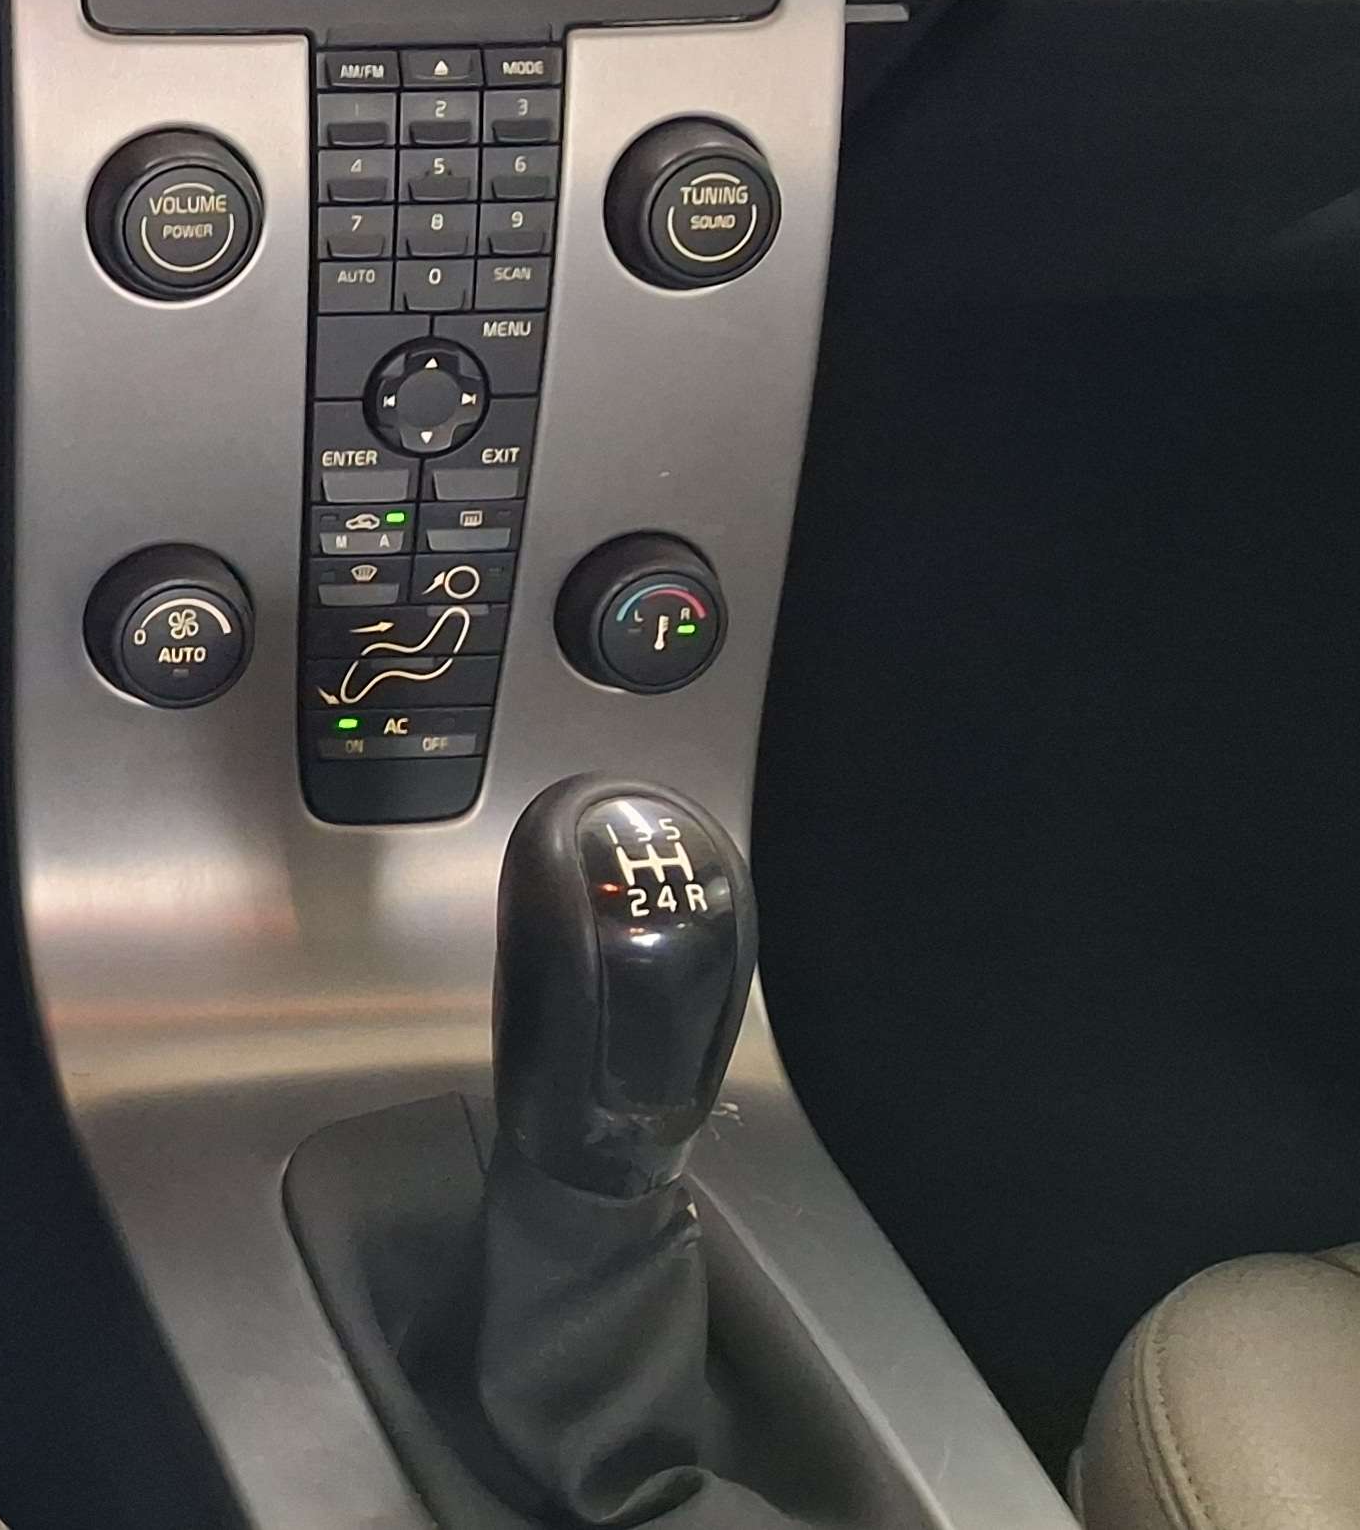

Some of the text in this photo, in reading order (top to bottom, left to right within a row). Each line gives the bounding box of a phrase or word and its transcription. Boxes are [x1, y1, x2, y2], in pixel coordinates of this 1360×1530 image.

[340, 64, 384, 79] AM/FM
[502, 60, 544, 76] MODE
[435, 100, 447, 118] 2
[517, 99, 528, 116] 3
[350, 159, 362, 173] 4
[433, 157, 445, 175] 5
[515, 156, 527, 172] 6
[680, 185, 748, 205] TUNING
[148, 194, 227, 215] VOLUME
[351, 215, 362, 231] 7
[431, 213, 443, 230] 8
[511, 211, 523, 228] 9
[690, 214, 736, 230] SOUND
[163, 223, 213, 239] POWER
[337, 269, 375, 284] AUTO
[429, 268, 441, 285] 0
[494, 267, 531, 281] SCAN
[483, 321, 531, 338] MENU
[322, 450, 378, 467] ENTER
[481, 447, 520, 464] EXIT
[335, 534, 348, 549] M
[379, 533, 390, 548] A
[158, 646, 207, 663] AUTO
[383, 718, 409, 735] AC
[422, 737, 449, 751] OFF
[658, 818, 681, 840] 5
[627, 888, 650, 917] 2
[656, 885, 677, 913] 4
[685, 883, 708, 912] R
